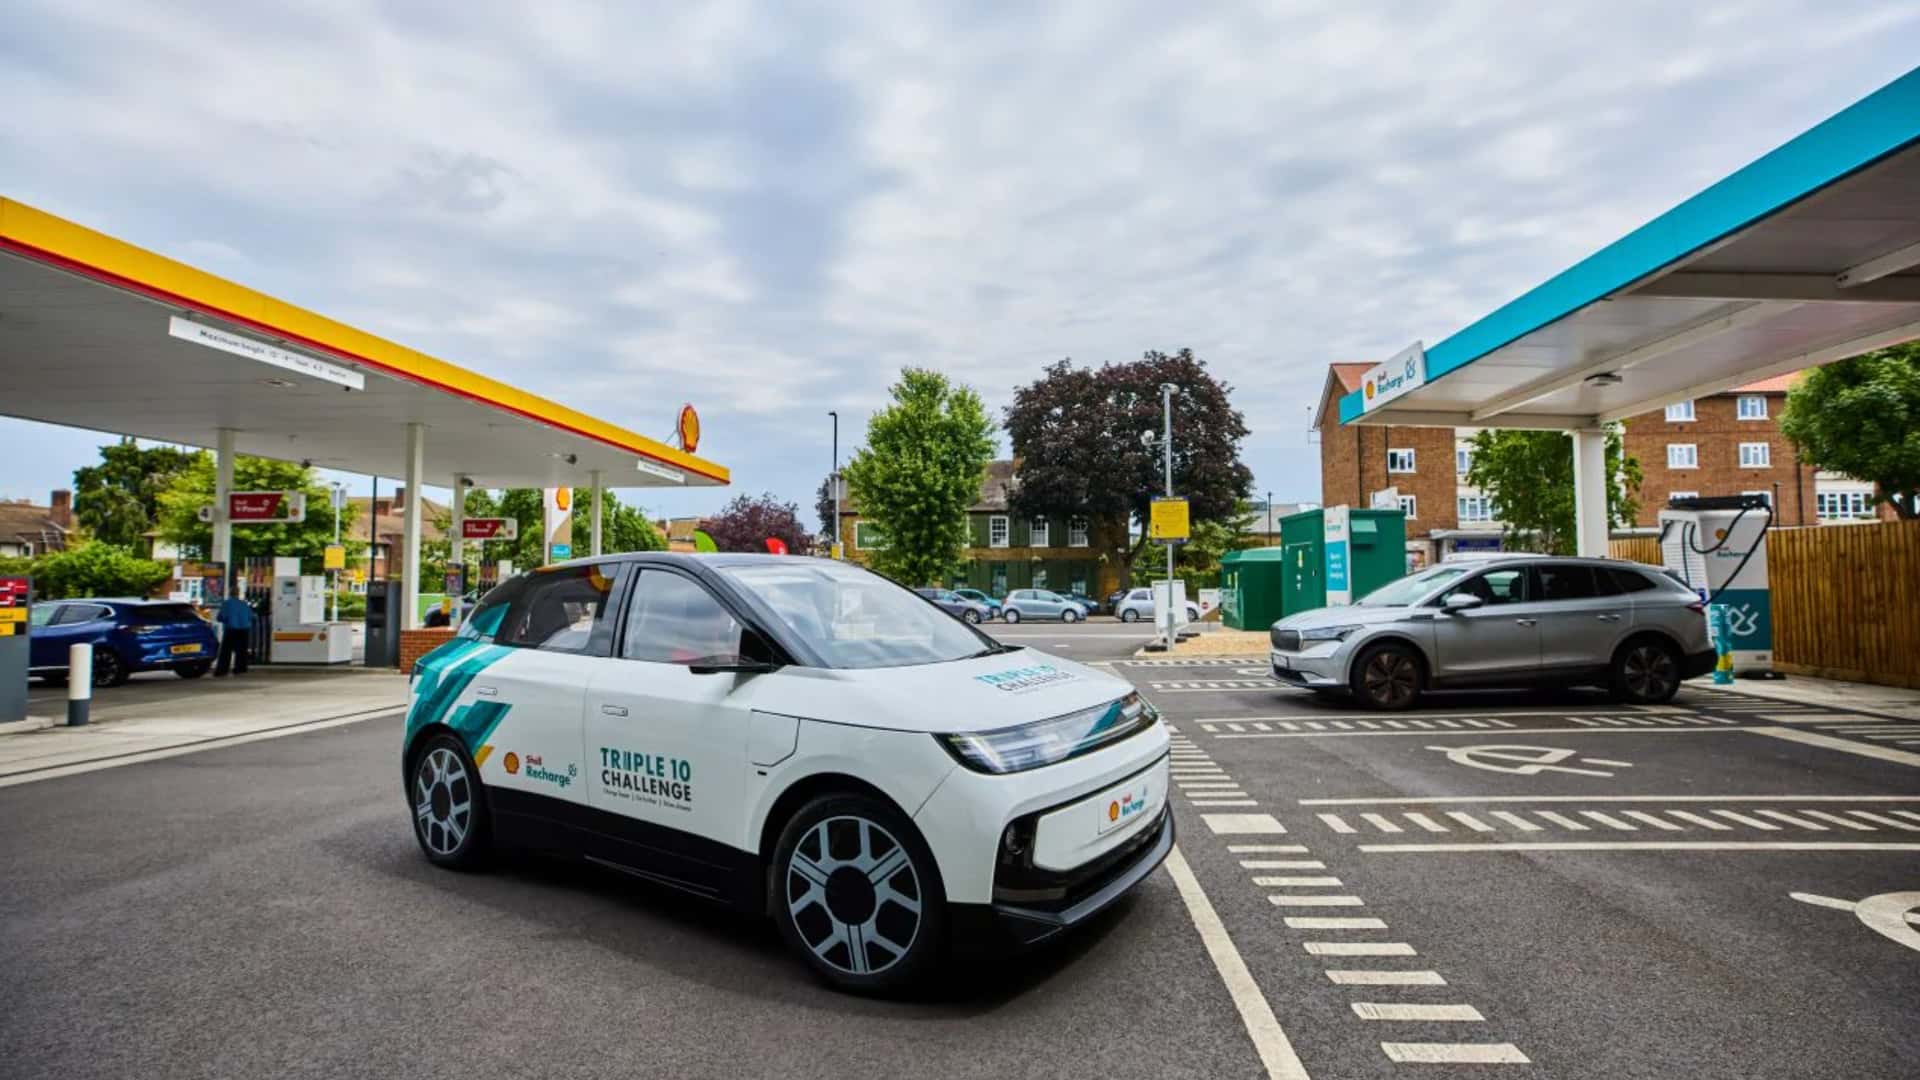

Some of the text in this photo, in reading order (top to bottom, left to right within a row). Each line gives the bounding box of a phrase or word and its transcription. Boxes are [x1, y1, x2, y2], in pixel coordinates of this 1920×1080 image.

[526, 754, 542, 766] Shell
[670, 758, 691, 782] 10
[526, 765, 571, 788] Recharge
[601, 769, 692, 802] CHALLENGE
